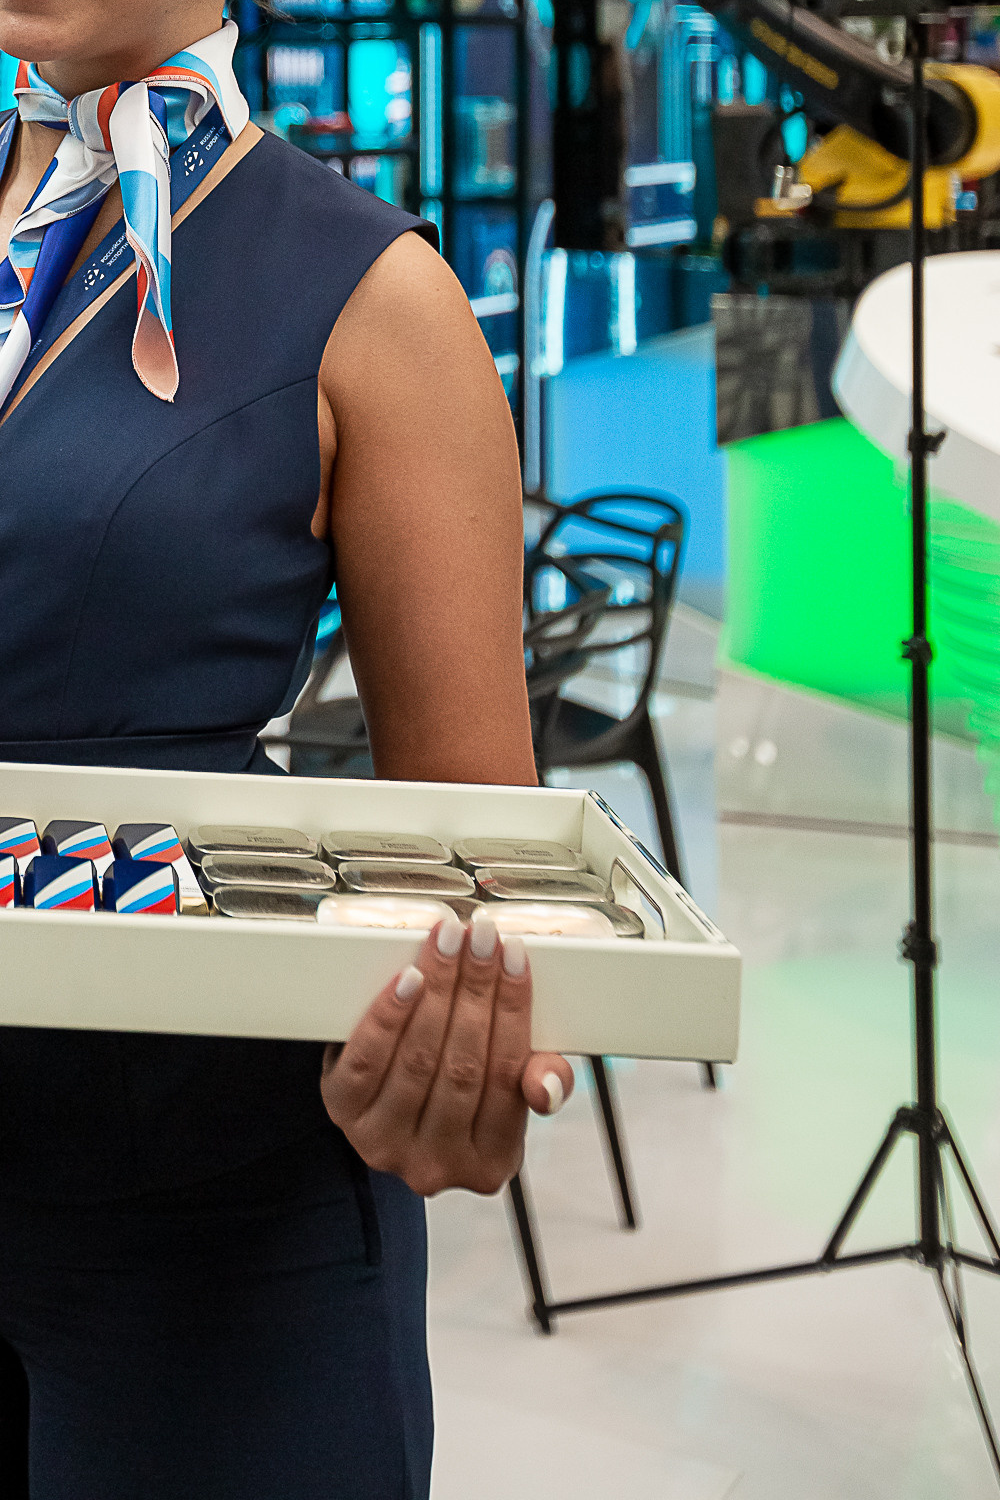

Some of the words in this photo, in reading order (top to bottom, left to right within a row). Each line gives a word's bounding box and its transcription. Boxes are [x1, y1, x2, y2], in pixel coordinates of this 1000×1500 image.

[200, 126, 216, 146] RUSSIAN
[205, 133, 220, 151] EXPORT
[106, 242, 129, 267] ЭКСПОРТН
